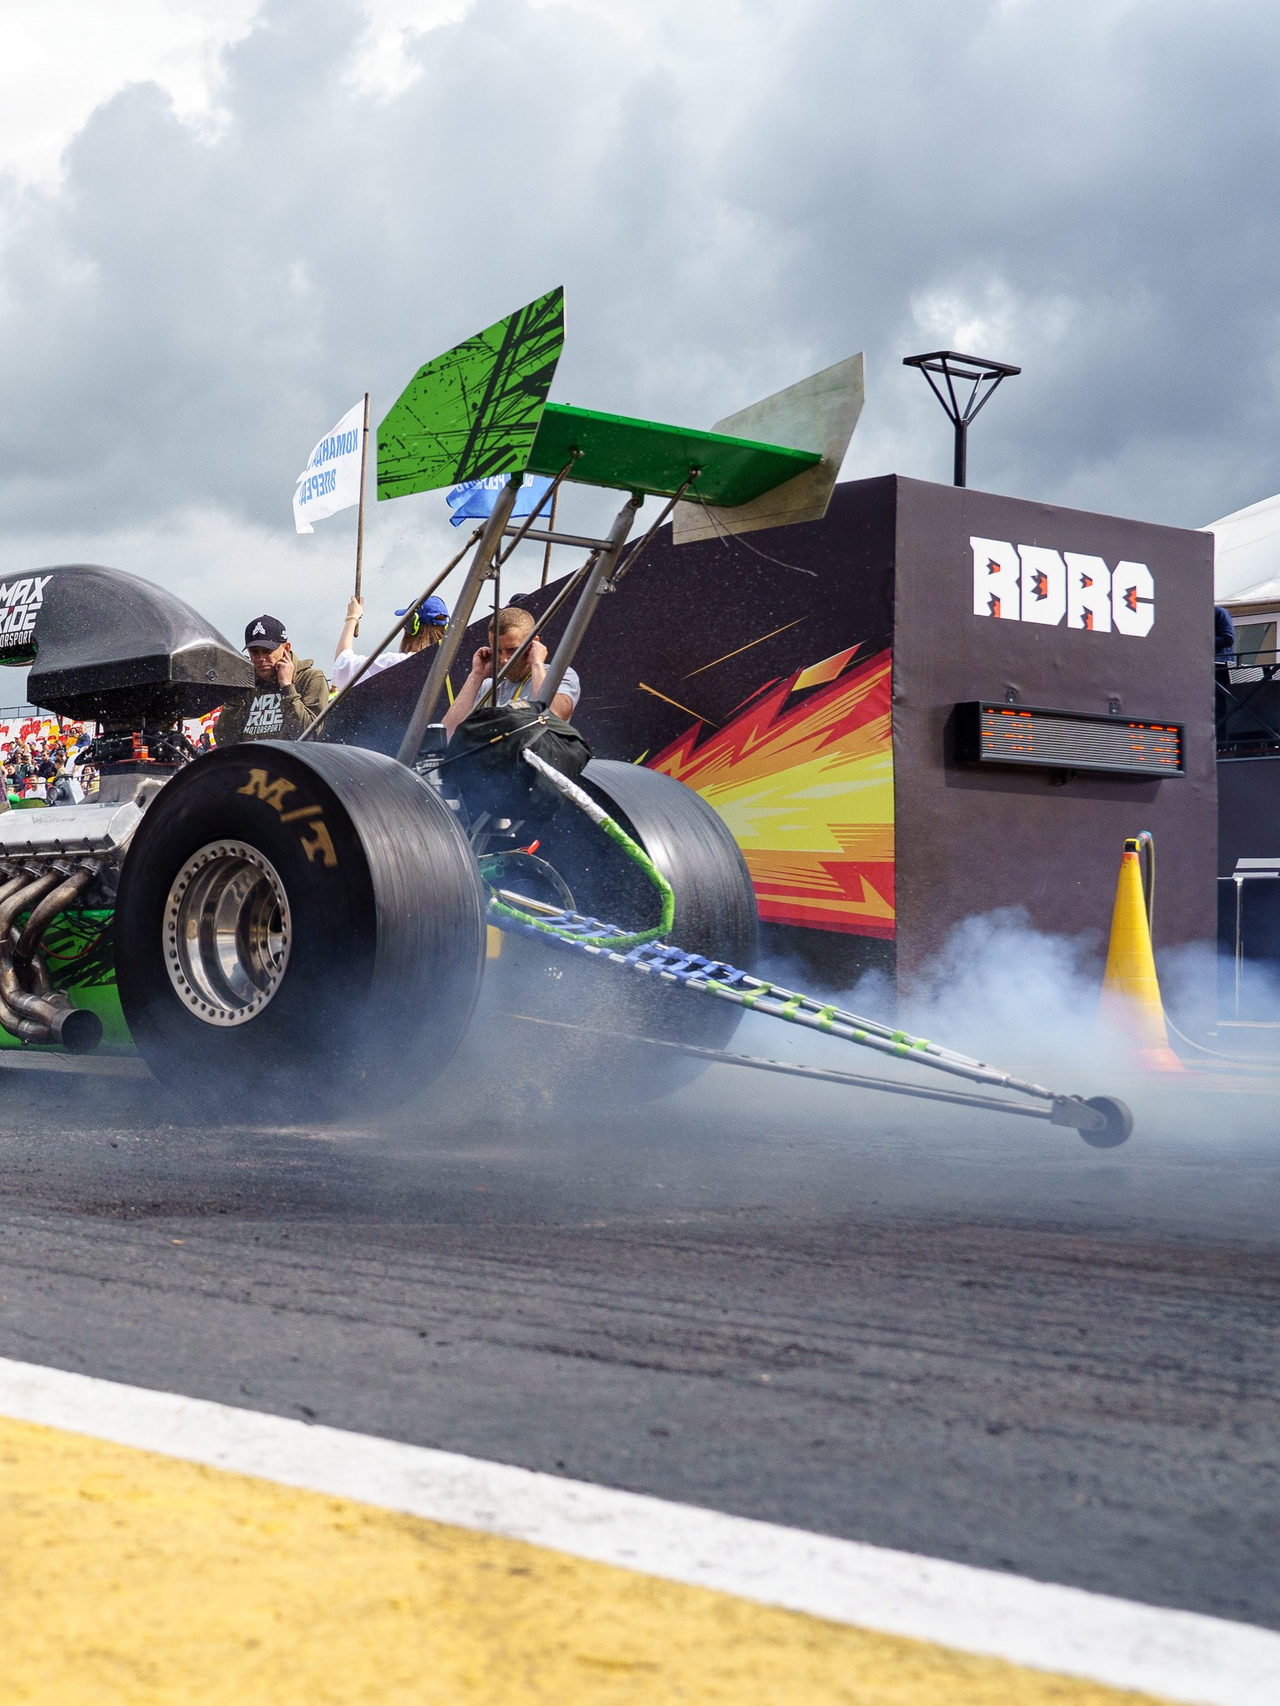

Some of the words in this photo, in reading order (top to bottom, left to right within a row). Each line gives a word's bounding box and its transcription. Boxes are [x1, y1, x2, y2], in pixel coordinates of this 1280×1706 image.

[970, 536, 1155, 638] RDRC
[243, 723, 282, 735] MOTORSPORT
[236, 768, 338, 868] M/T
